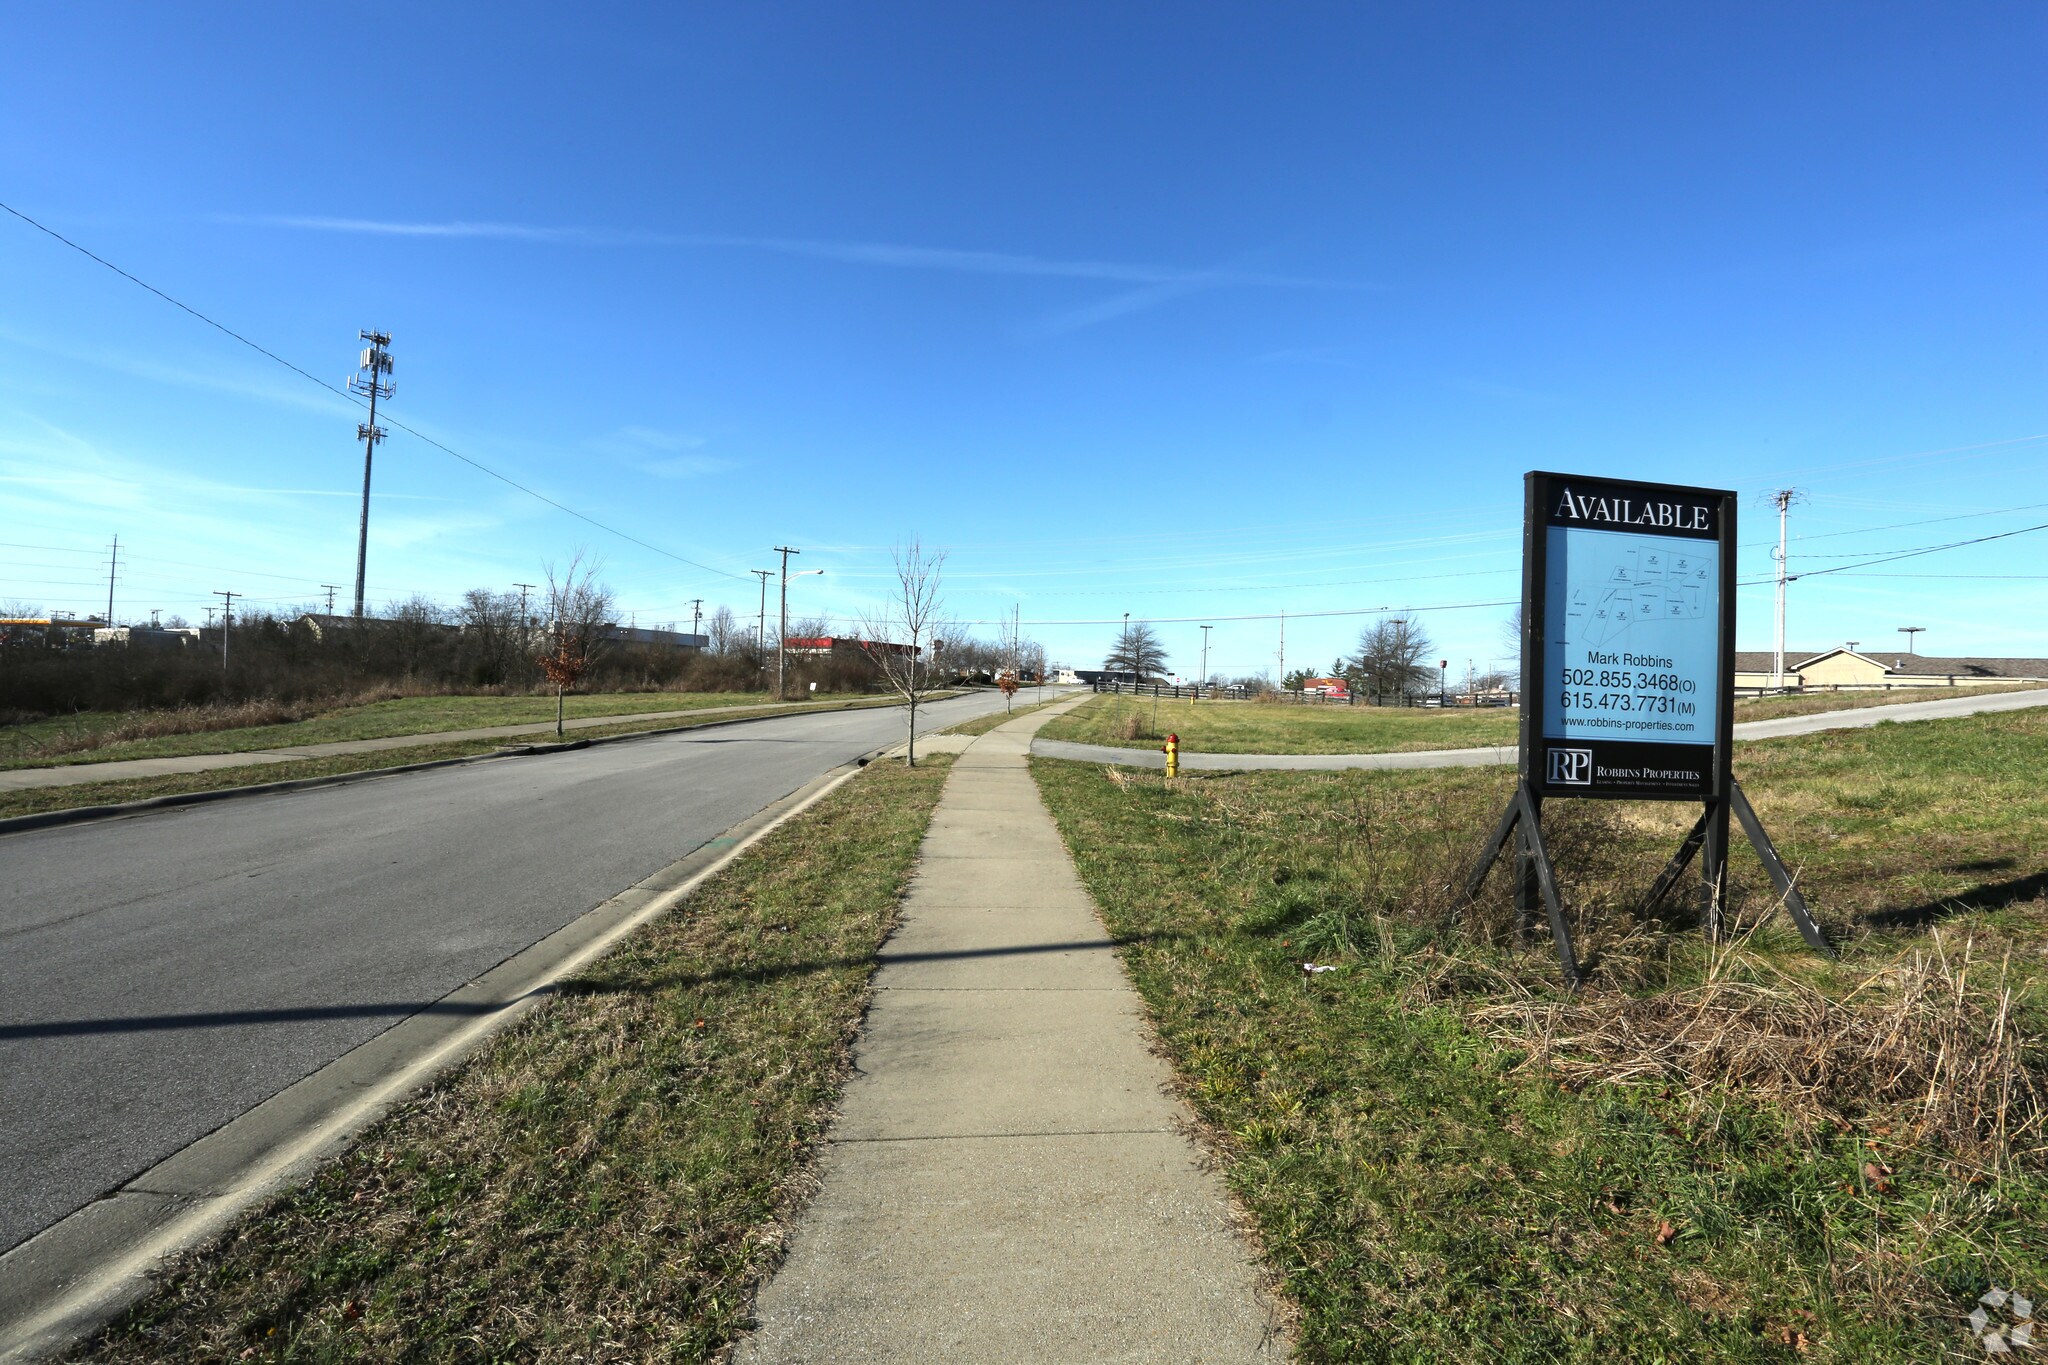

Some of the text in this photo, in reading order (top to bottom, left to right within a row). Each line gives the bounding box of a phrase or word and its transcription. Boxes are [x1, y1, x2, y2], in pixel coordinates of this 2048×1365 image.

[1555, 487, 1709, 530] AVAILABLE
[1588, 651, 1673, 668] Mark Robbins
[1561, 718, 1695, 731] www.robbins-properties.com
[1551, 751, 1589, 781] RP
[1596, 766, 1700, 780] ROBBINS PROPERTIES
